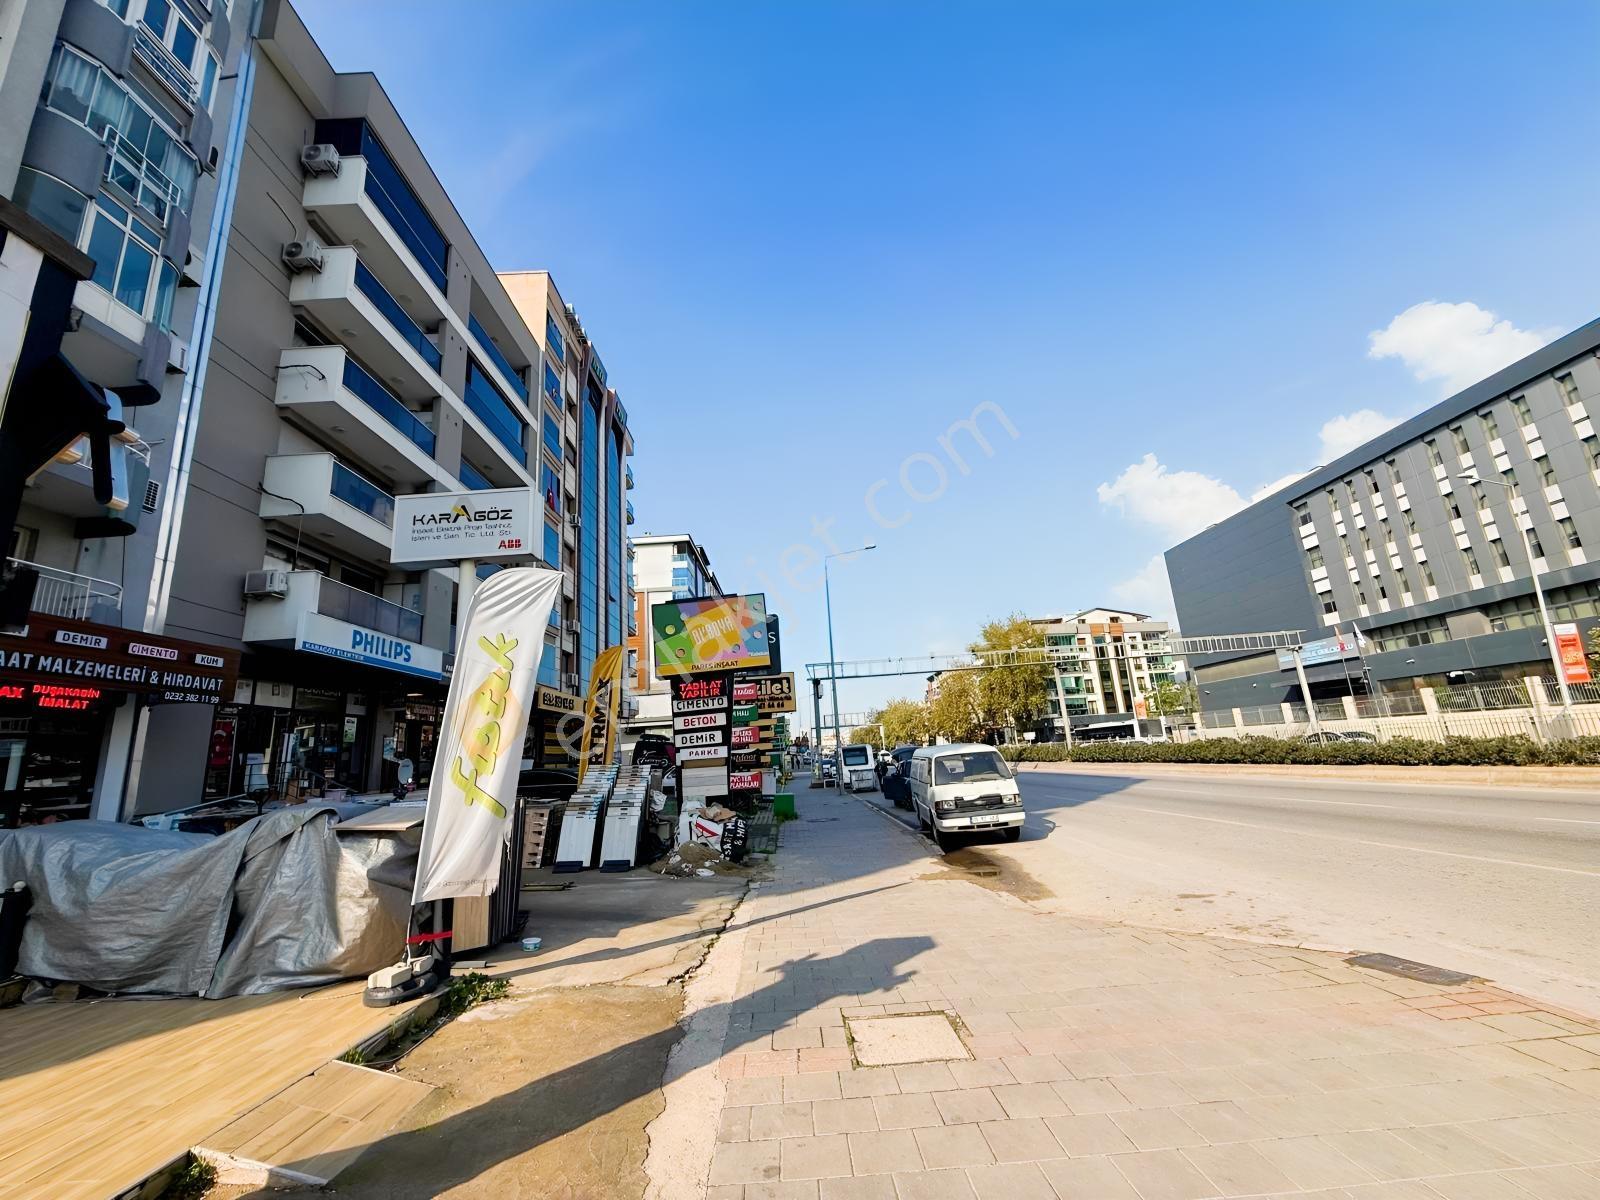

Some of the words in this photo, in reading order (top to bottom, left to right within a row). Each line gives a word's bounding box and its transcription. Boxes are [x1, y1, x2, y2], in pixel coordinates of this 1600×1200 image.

[412, 504, 513, 526] KARAGÖZ
[498, 538, 522, 549] ABB
[62, 632, 102, 647] DEMİR
[352, 629, 412, 662] PHILIPS
[200, 656, 218, 665] KUM
[37, 655, 147, 682] MALZEMELERİ
[149, 670, 159, 684] &
[163, 671, 223, 691] HIRDAVAT
[679, 680, 722, 692] TADİLAT
[39, 695, 90, 710] İMALAT
[165, 691, 184, 701] 0232
[201, 695, 208, 703] 11
[210, 695, 219, 703] 99
[683, 715, 717, 728] BETON
[681, 733, 716, 745] DEMİR
[689, 748, 719, 757] PARKE
